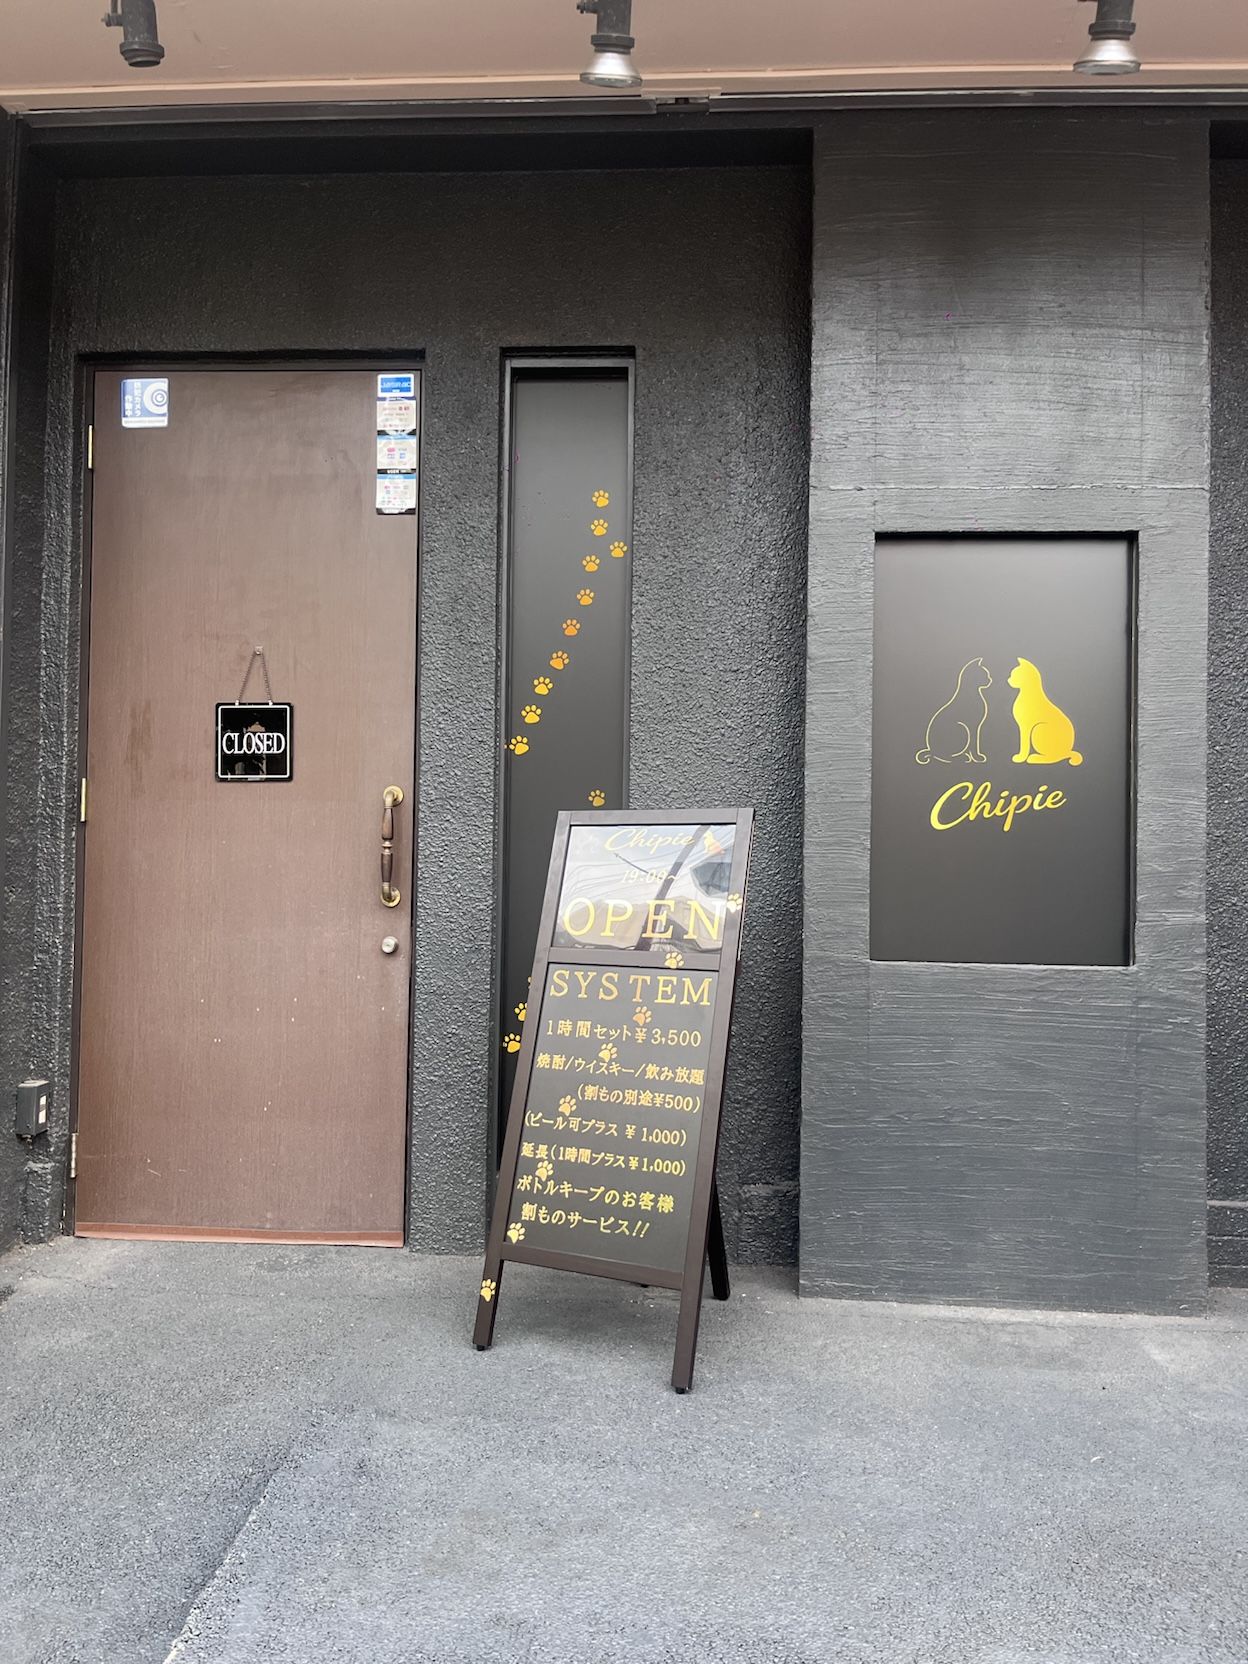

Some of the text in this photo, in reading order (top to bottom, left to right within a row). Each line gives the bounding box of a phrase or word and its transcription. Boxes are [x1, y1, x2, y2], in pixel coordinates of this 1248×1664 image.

[222, 732, 285, 754] CLOSED
[930, 781, 1067, 832] Chipie
[604, 828, 695, 854] Chipie
[563, 897, 727, 940] OPEN
[549, 969, 713, 1006] SYSTEM
